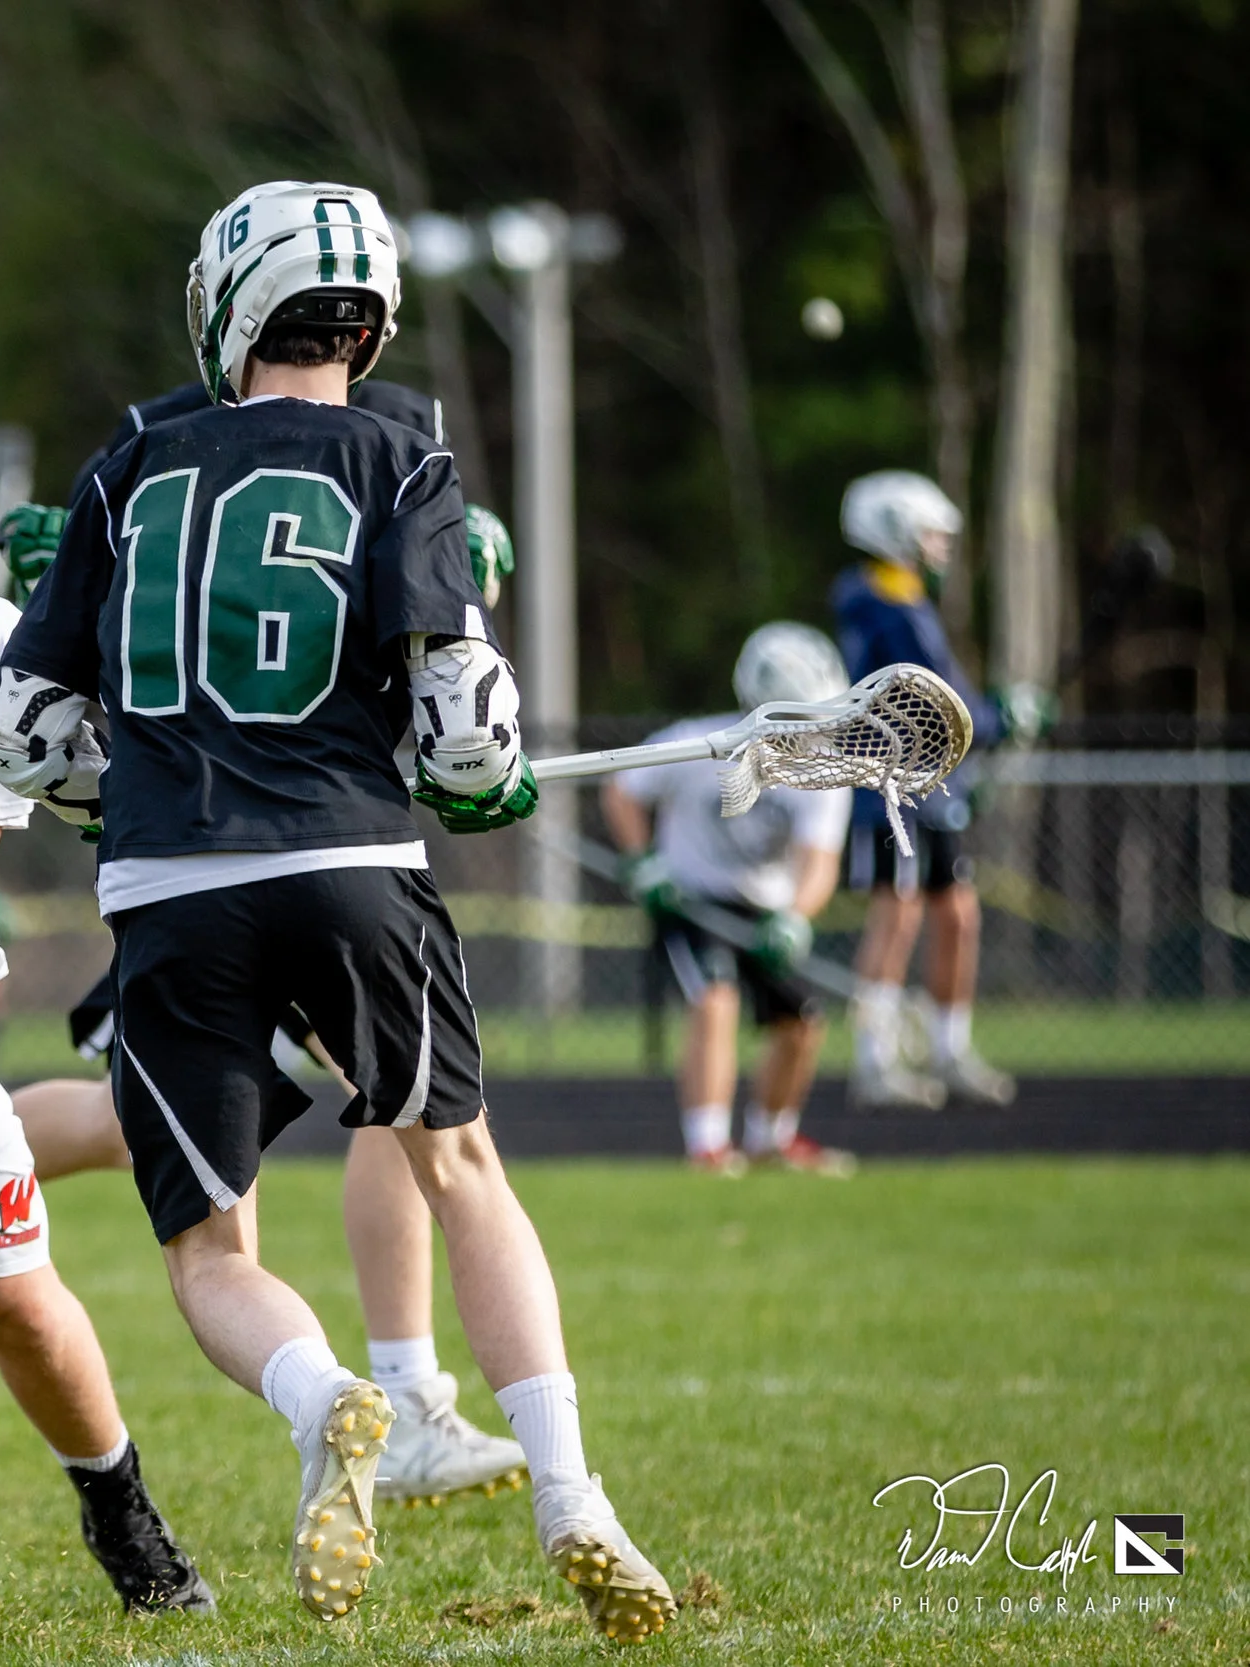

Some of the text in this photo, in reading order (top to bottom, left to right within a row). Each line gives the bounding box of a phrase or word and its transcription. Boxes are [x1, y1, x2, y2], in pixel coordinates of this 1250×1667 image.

[217, 204, 250, 263] 16
[120, 467, 362, 724] 16
[451, 758, 485, 771] STX
